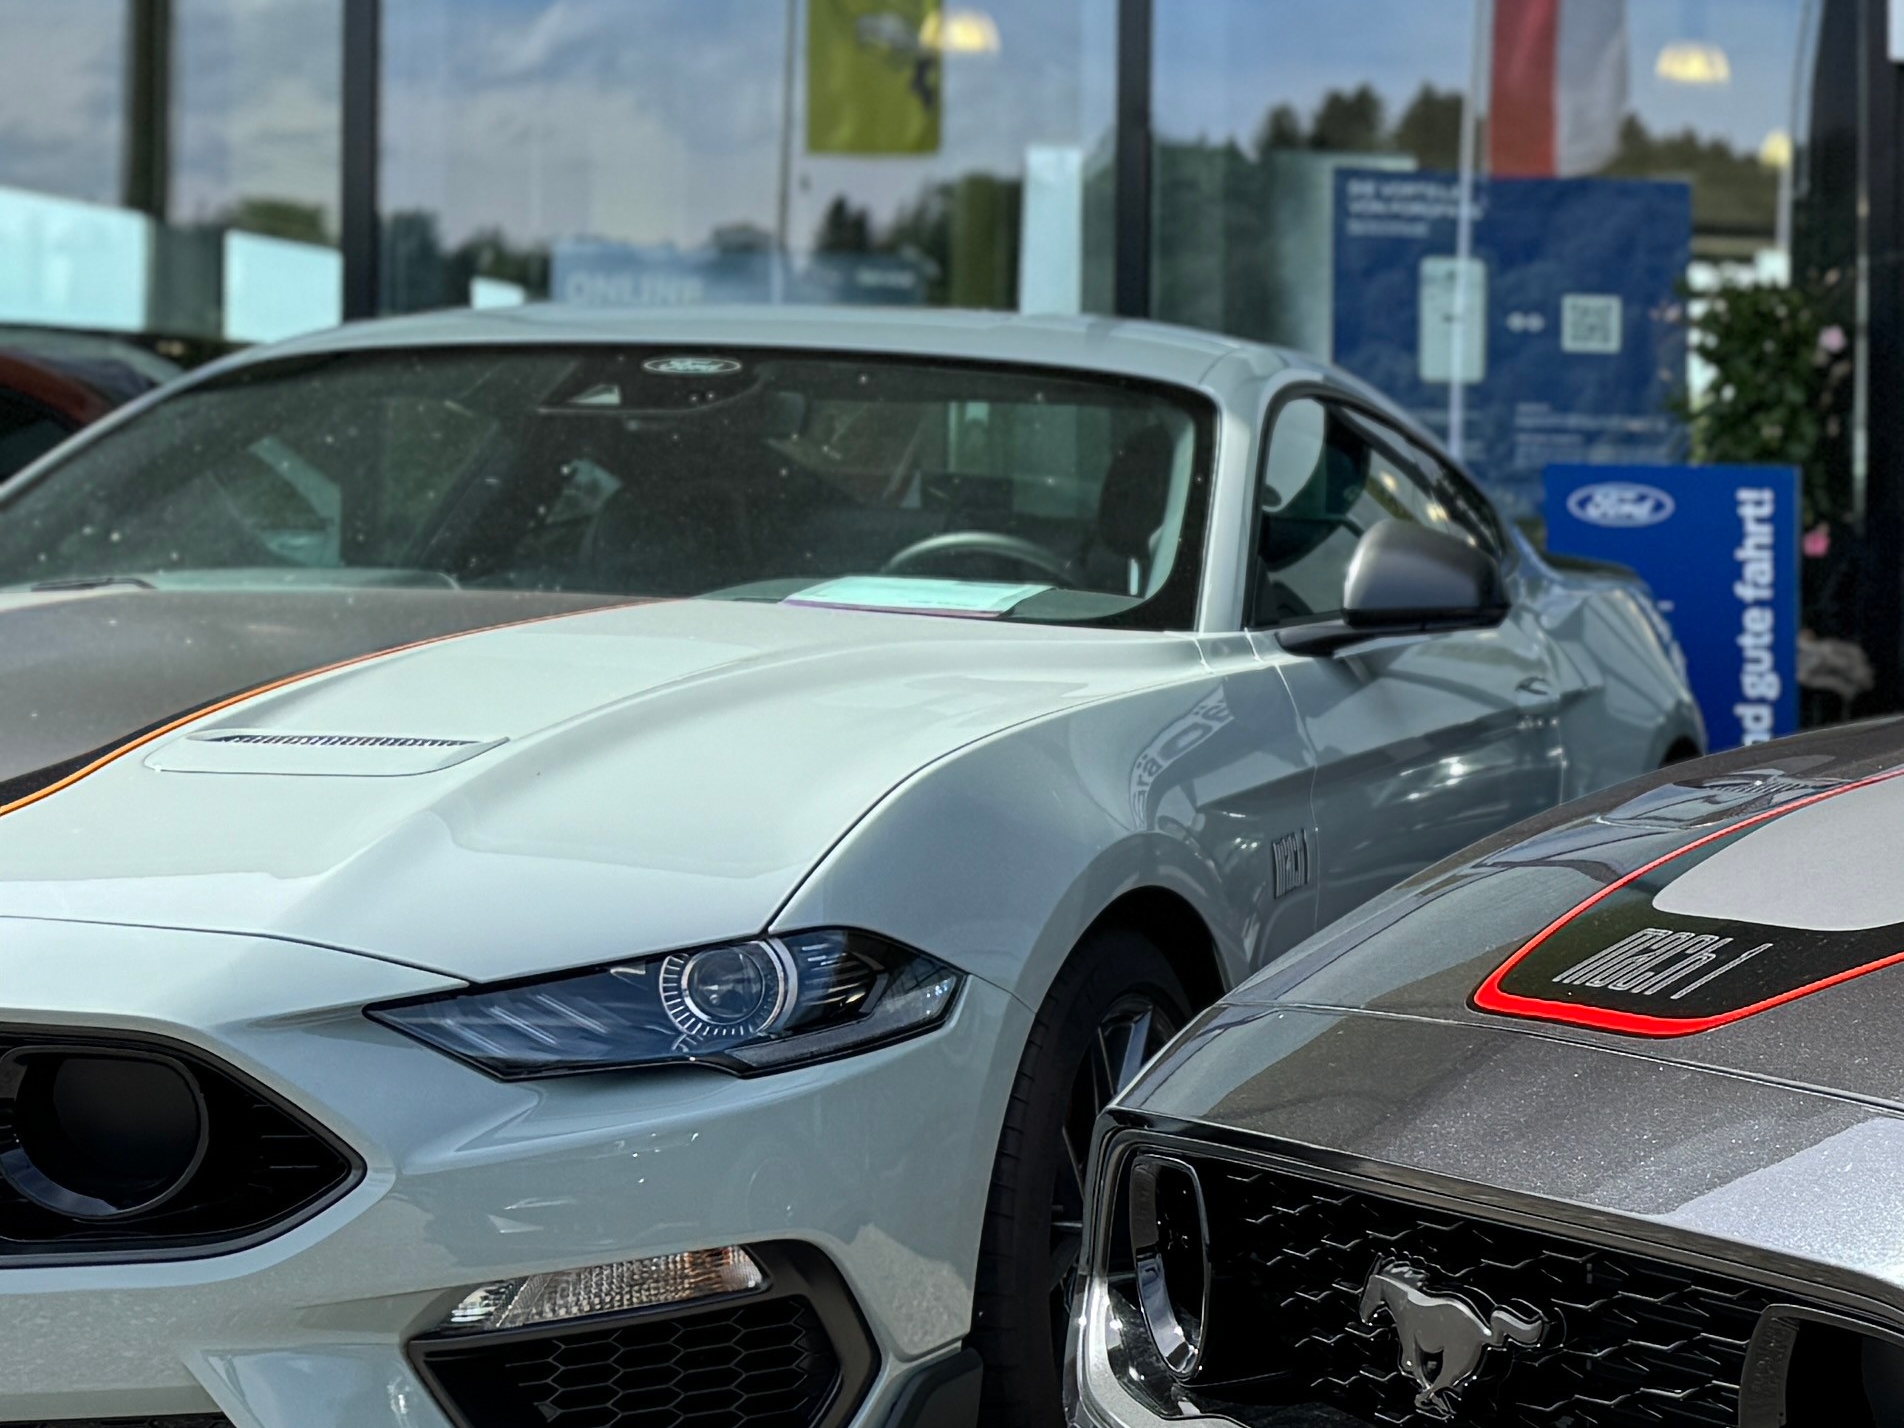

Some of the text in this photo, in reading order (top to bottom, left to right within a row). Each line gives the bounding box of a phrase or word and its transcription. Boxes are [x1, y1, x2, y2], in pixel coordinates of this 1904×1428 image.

[1579, 484, 1660, 522] Ford
[1733, 487, 1775, 603] fahrt!
[1735, 606, 1781, 702] gute
